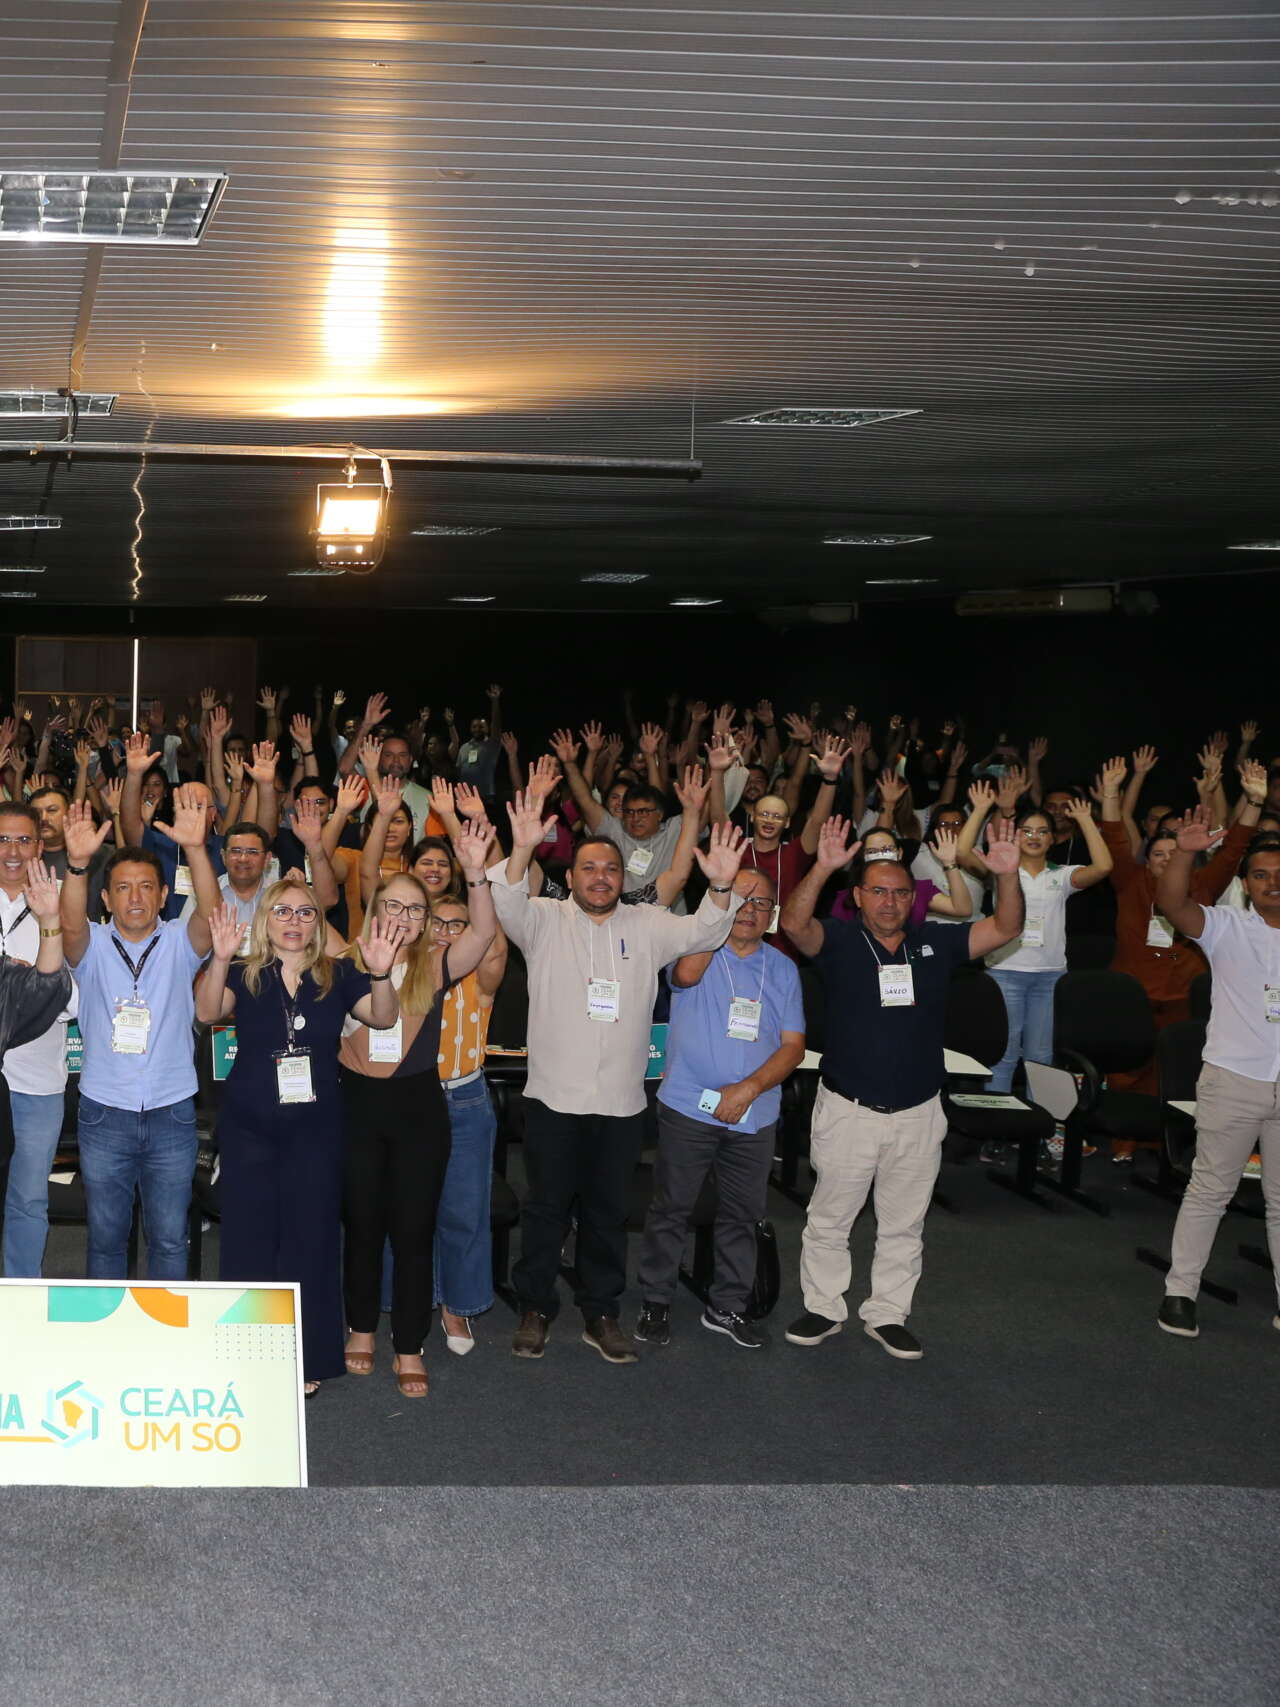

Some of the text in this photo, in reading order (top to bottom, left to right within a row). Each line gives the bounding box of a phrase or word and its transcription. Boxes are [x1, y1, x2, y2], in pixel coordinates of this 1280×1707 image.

[119, 1380, 246, 1419] CEARÁ
[123, 1414, 242, 1453] UM SÓ
